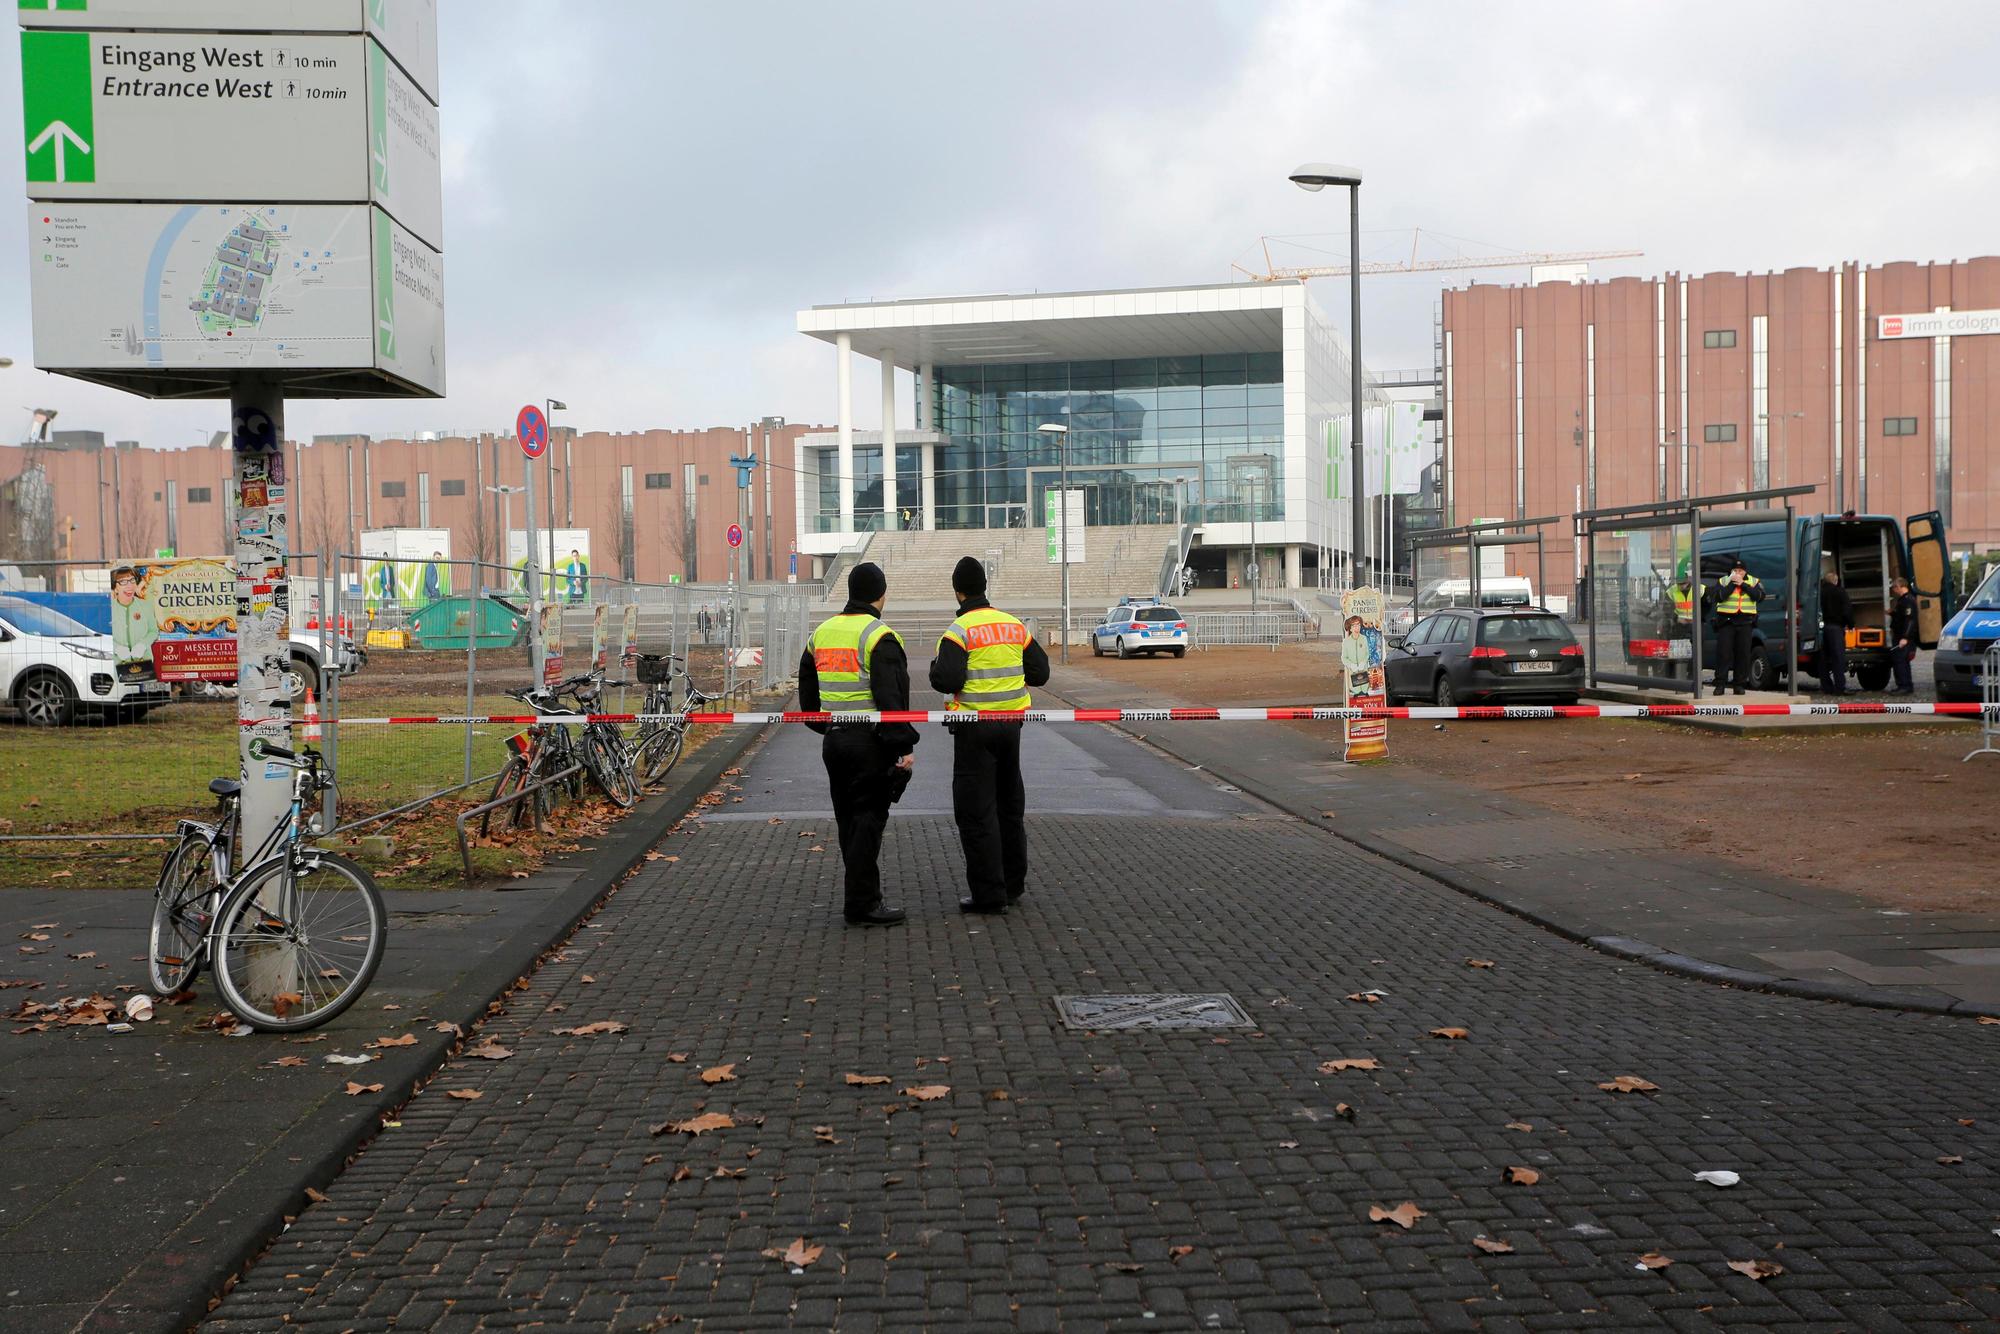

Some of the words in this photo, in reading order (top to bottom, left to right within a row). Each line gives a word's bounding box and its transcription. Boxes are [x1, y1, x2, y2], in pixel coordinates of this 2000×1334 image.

[102, 45, 196, 73] Eingang
[201, 47, 264, 68] West
[294, 57, 309, 68] 10
[313, 57, 337, 68] min
[103, 76, 209, 97] Entrance
[215, 78, 273, 98] West
[306, 88, 321, 99] 10
[322, 87, 347, 99] min
[394, 234, 414, 270] Eingang
[414, 248, 426, 272] Nord
[395, 263, 417, 293] Entrance
[1908, 318, 1943, 331] imm
[163, 582, 214, 595] PANEM
[220, 581, 236, 593] ET
[969, 624, 1024, 646] POLIZEI
[166, 645, 174, 654] 9
[184, 643, 211, 652] MESSE
[212, 642, 235, 651] CITY
